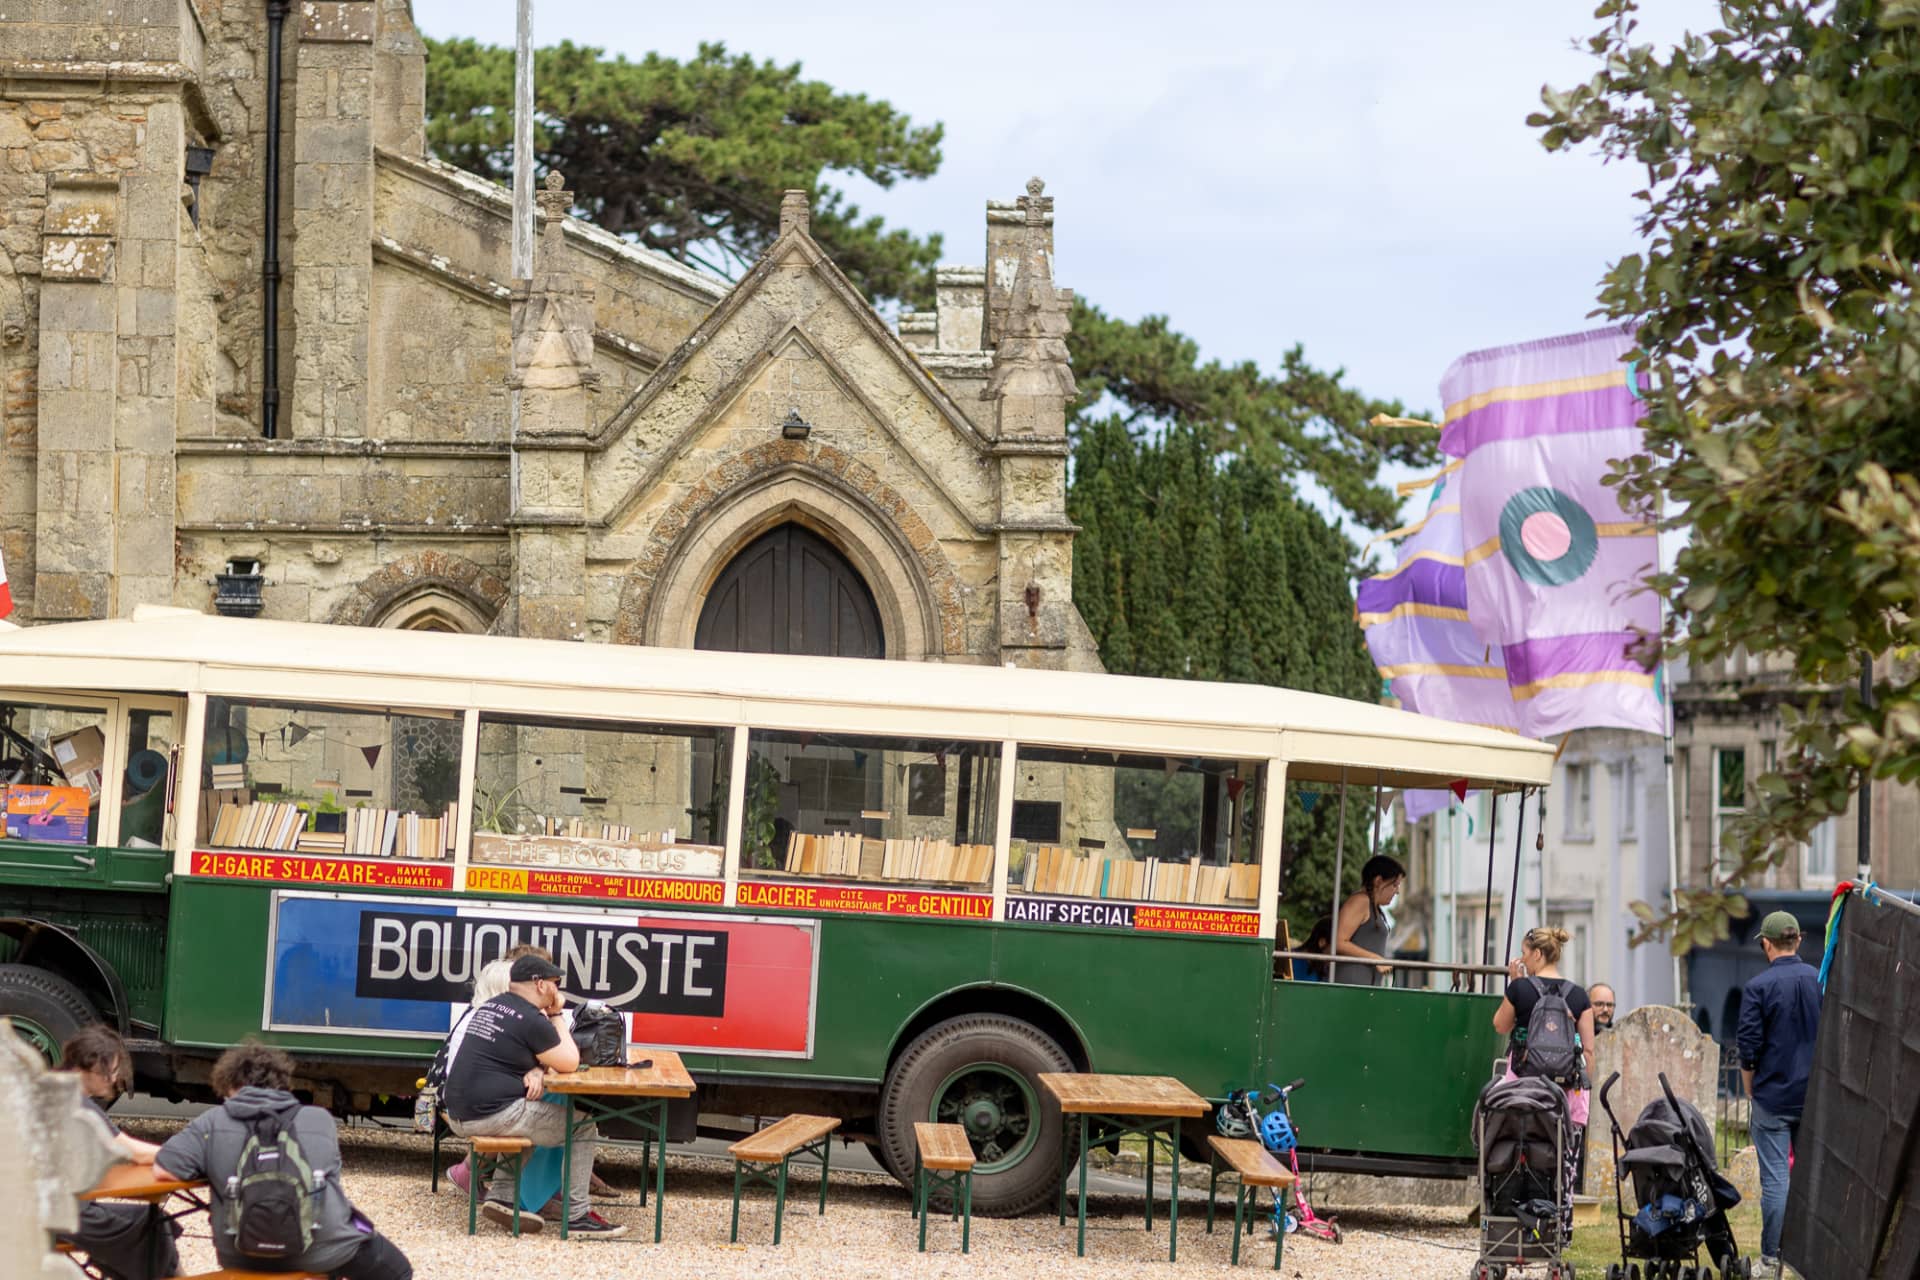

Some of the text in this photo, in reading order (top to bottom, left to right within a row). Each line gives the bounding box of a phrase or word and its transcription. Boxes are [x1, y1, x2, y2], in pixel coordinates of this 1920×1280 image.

[558, 844, 628, 867] BOOK
[640, 850, 688, 871] BUS
[397, 866, 431, 877] HAVRE
[384, 876, 443, 888] CAUMARTIN
[603, 877, 624, 888] GARE
[540, 884, 583, 895] CHATELET
[607, 887, 618, 897] DU
[626, 879, 722, 903] LUXEMBOURG
[819, 899, 884, 911] UNIVERSITAIRE
[906, 904, 918, 913] DE
[919, 895, 993, 917] GENTILLY
[1006, 901, 1057, 921] TARIF
[1138, 908, 1162, 919] GARE
[1165, 910, 1190, 921] SAINT
[1138, 918, 1171, 929] PALAIS
[496, 1004, 516, 1017] TOUR
